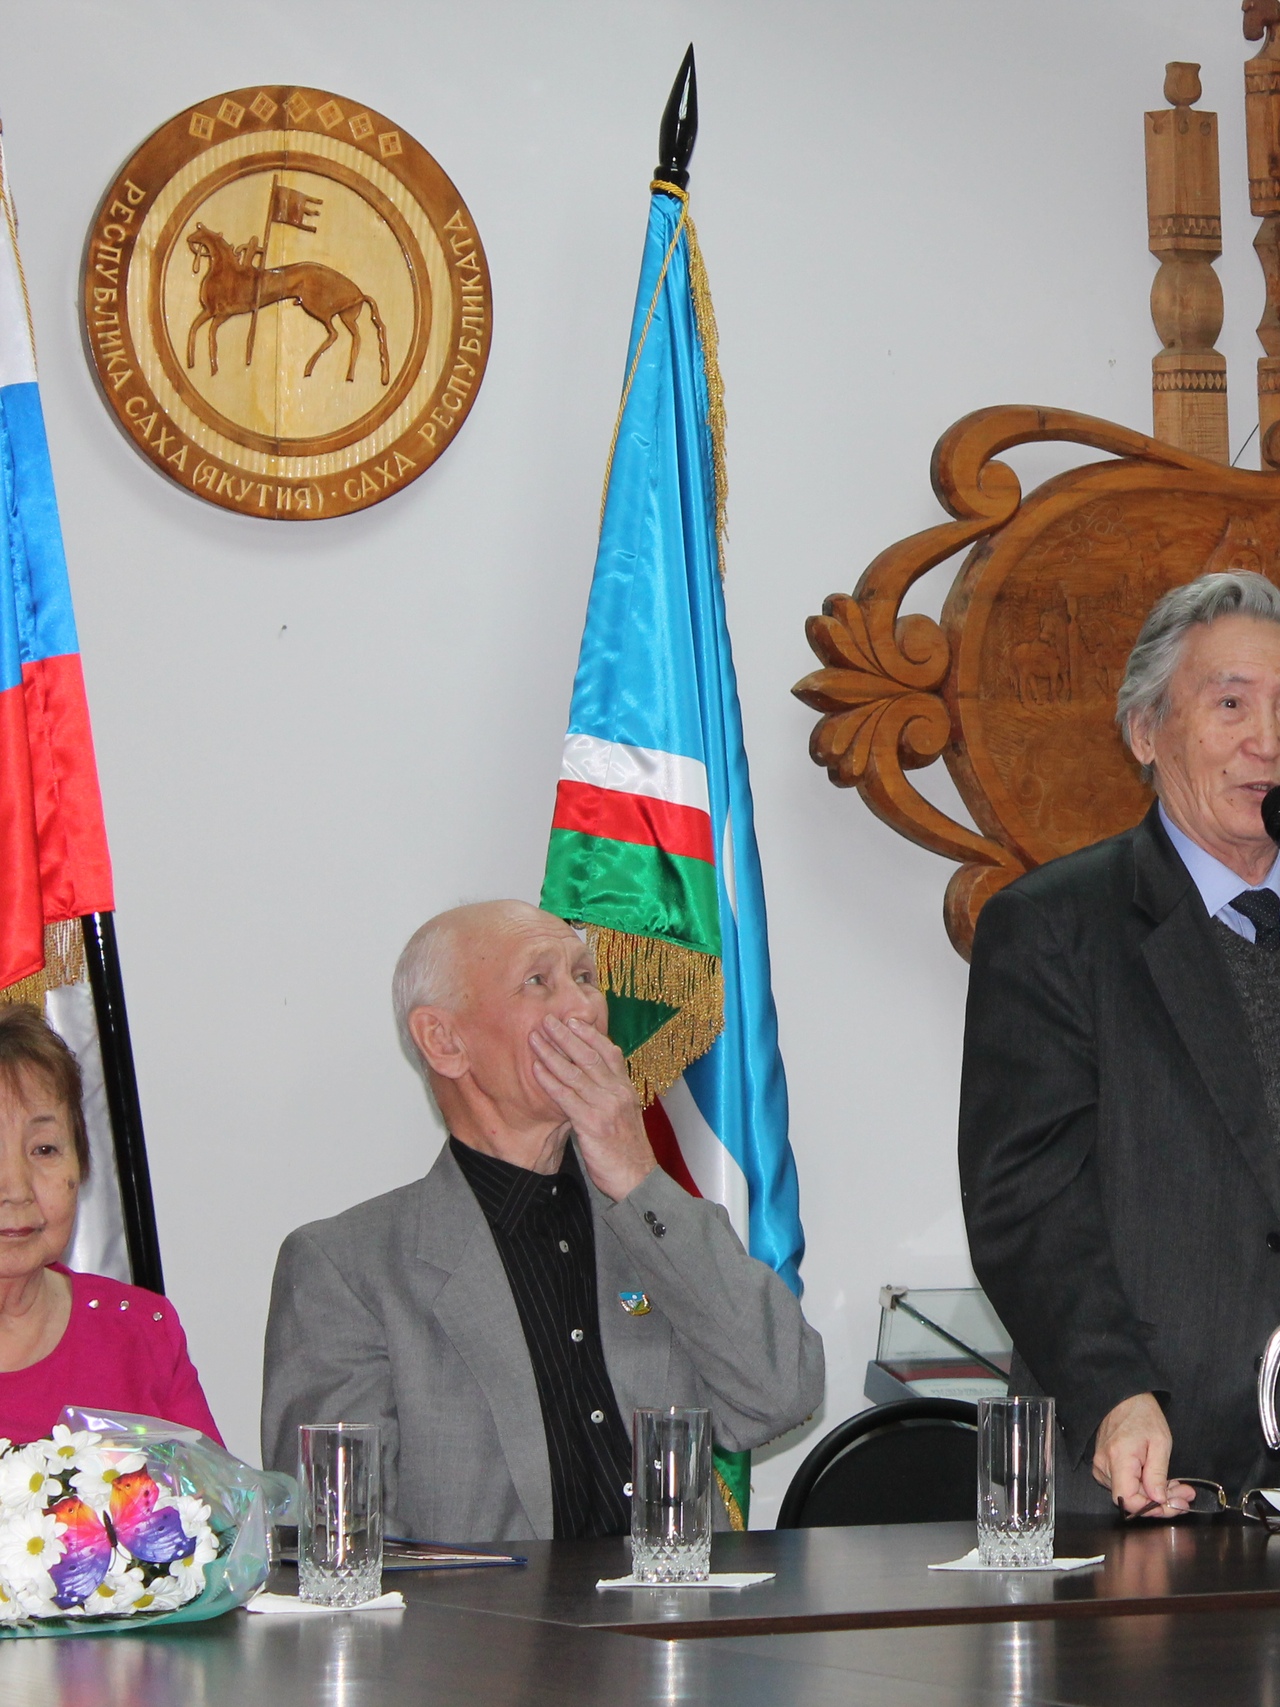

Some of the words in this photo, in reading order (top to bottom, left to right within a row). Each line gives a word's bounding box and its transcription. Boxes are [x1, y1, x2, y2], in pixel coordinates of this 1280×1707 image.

[93, 179, 146, 392] РЕСПУБЛИКА
[125, 395, 187, 472] САХА
[192, 458, 325, 512] (ЯКУТИЯ)
[343, 451, 417, 503] САХА
[418, 210, 485, 448] РЕСПУБЛИКАТА
